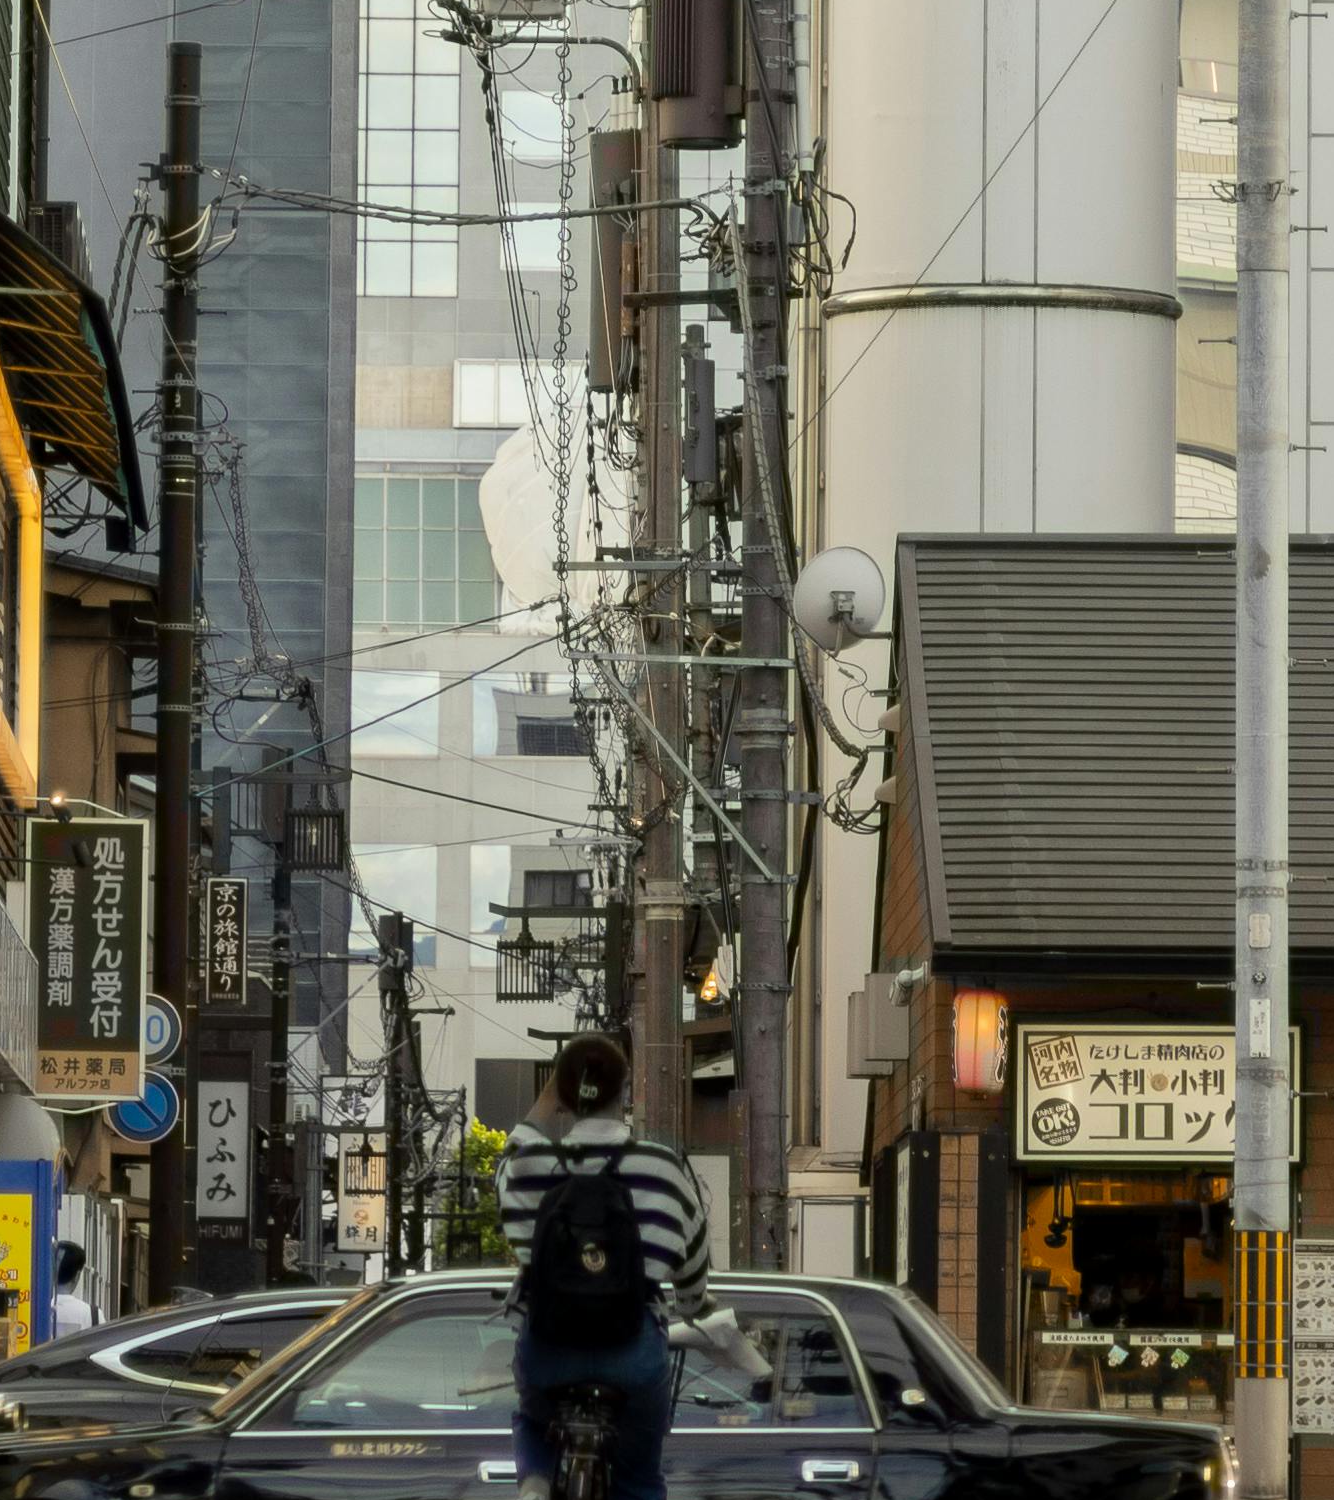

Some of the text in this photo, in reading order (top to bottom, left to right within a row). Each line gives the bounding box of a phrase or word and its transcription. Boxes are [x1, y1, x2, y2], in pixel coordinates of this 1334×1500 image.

[46, 866, 76, 1008] 漢方薬調剤
[89, 836, 125, 1039] 処方せん受付
[212, 882, 240, 992] 京の旅館通り
[1033, 1040, 1074, 1067] 河内
[1089, 1043, 1225, 1062] たけしま精肉店の
[40, 1056, 126, 1078] 松井薬局
[1040, 1059, 1080, 1084] 名物
[53, 1077, 112, 1091] アルファ店
[1089, 1068, 1225, 1096] 大判 小判
[1038, 1109, 1076, 1133] OK!
[205, 1097, 238, 1202] ひふみ
[198, 1224, 243, 1239] HIFUMI
